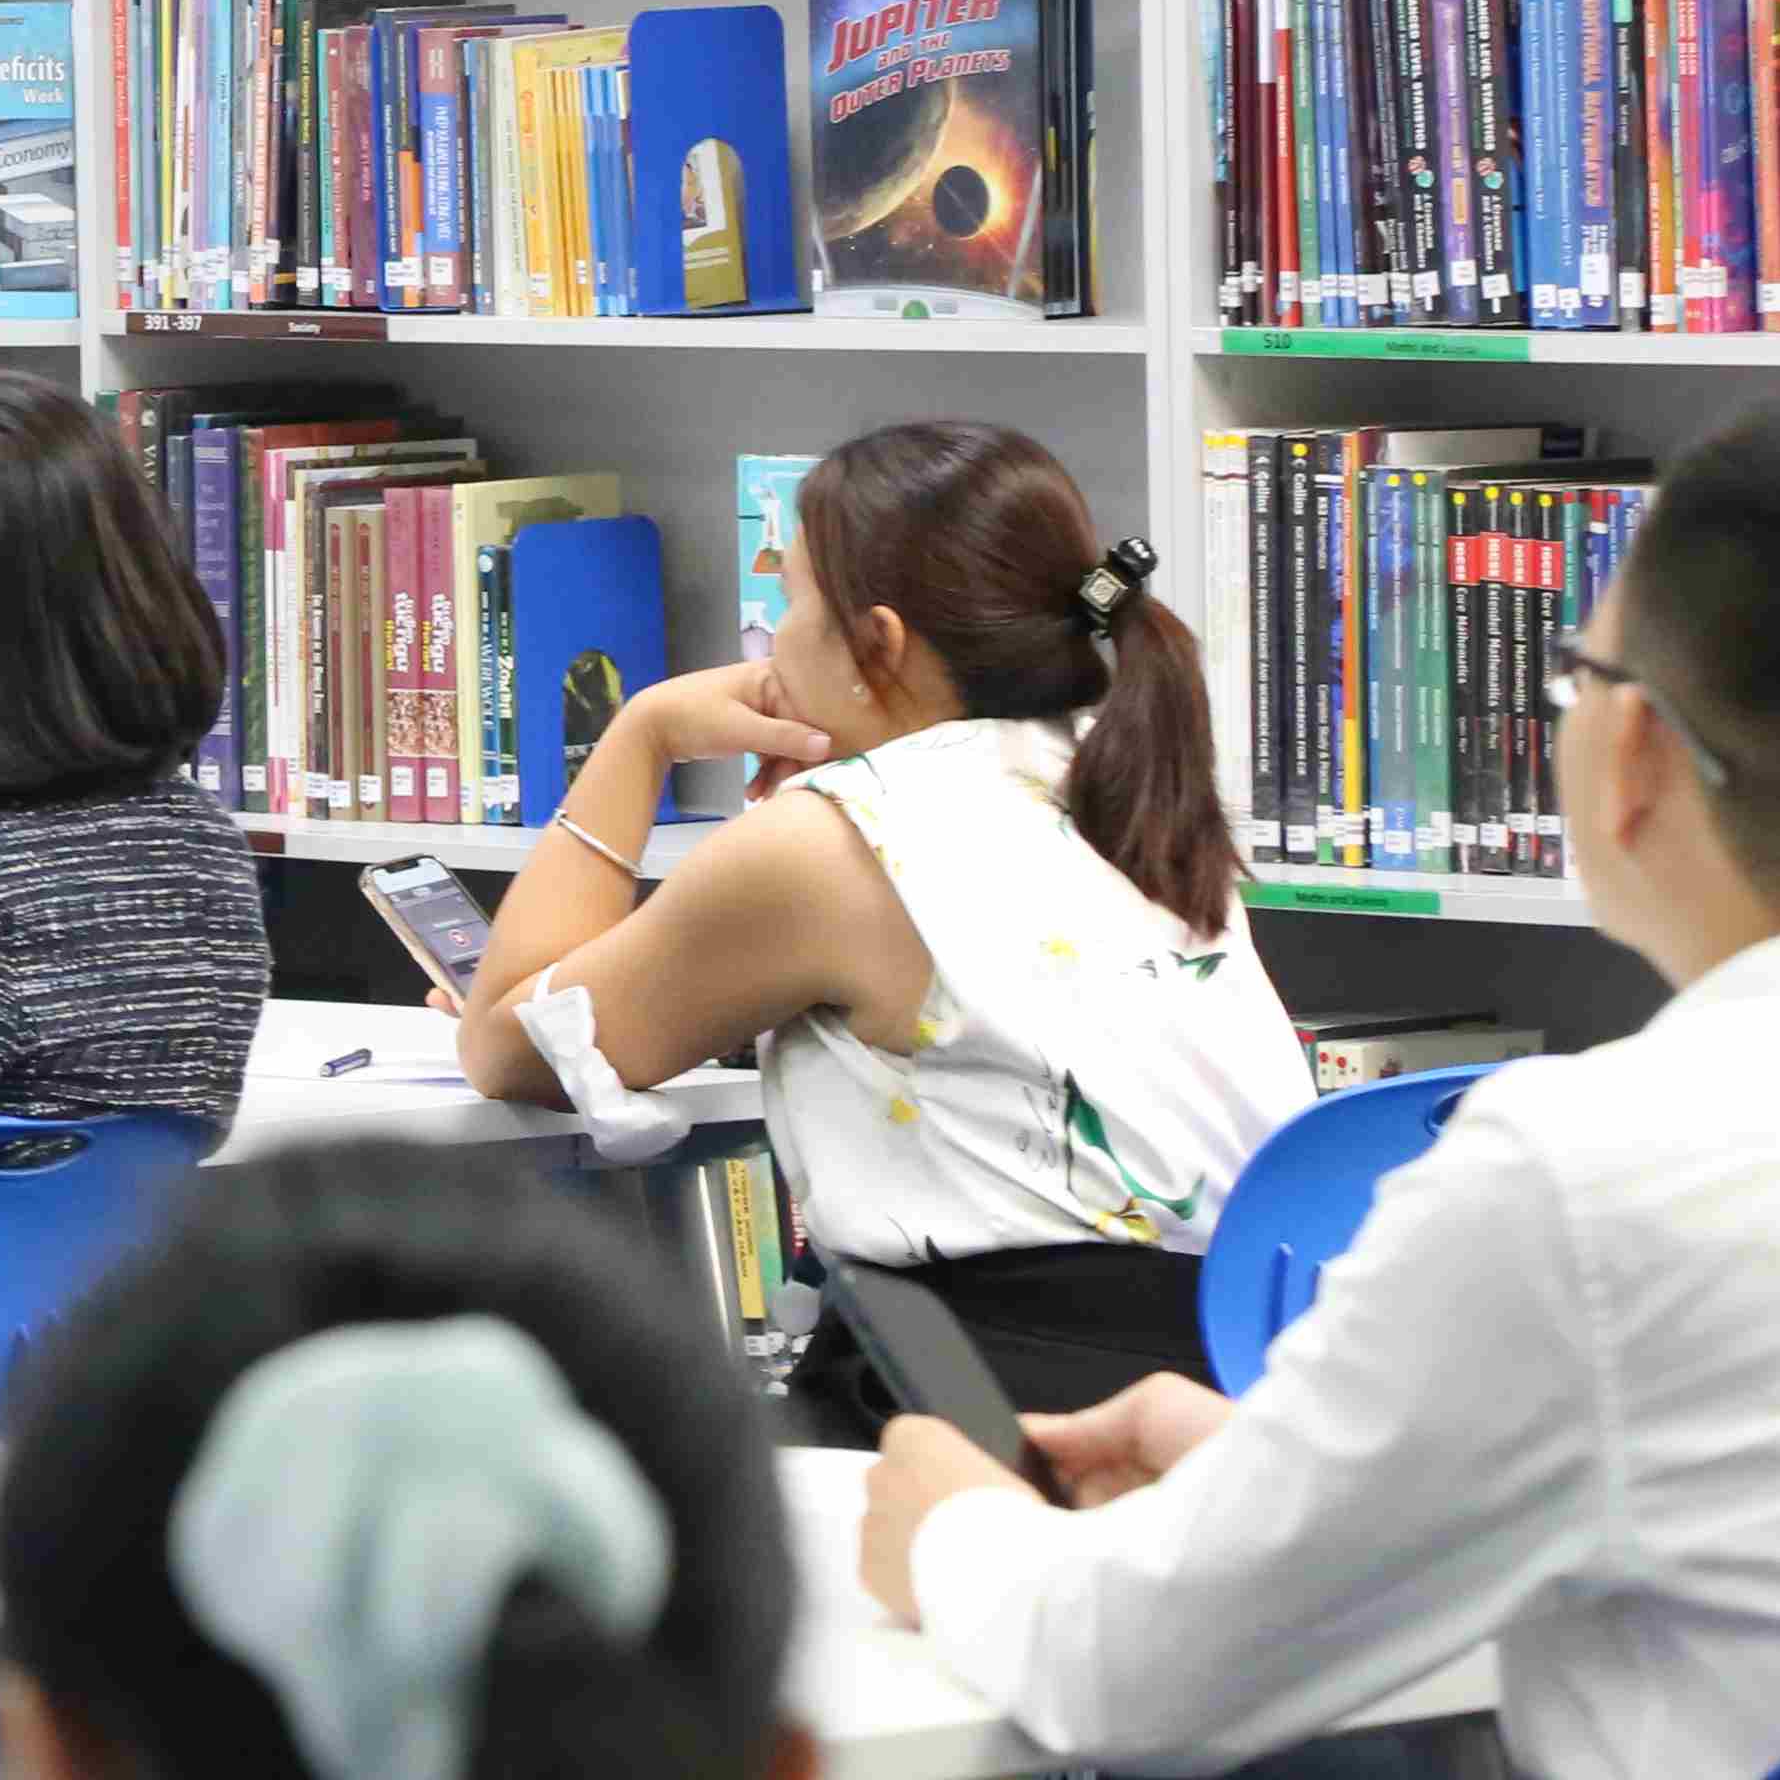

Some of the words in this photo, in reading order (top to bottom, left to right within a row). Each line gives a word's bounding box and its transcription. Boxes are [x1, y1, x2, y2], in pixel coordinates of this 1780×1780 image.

[1409, 44, 1423, 79] LEVEL
[1479, 44, 1493, 79] LEVEL
[23, 88, 64, 104] Work
[829, 70, 904, 124] OUTER
[906, 48, 1012, 89] PLANETS
[143, 315, 171, 331] 391
[1254, 471, 1270, 514] Collins
[1292, 473, 1308, 516] Collins
[1455, 587, 1469, 614] Core
[1487, 584, 1501, 635] Extended
[1541, 592, 1554, 617] Core
[1455, 616, 1469, 684] Mathematics
[1486, 638, 1501, 707] Mathematics
